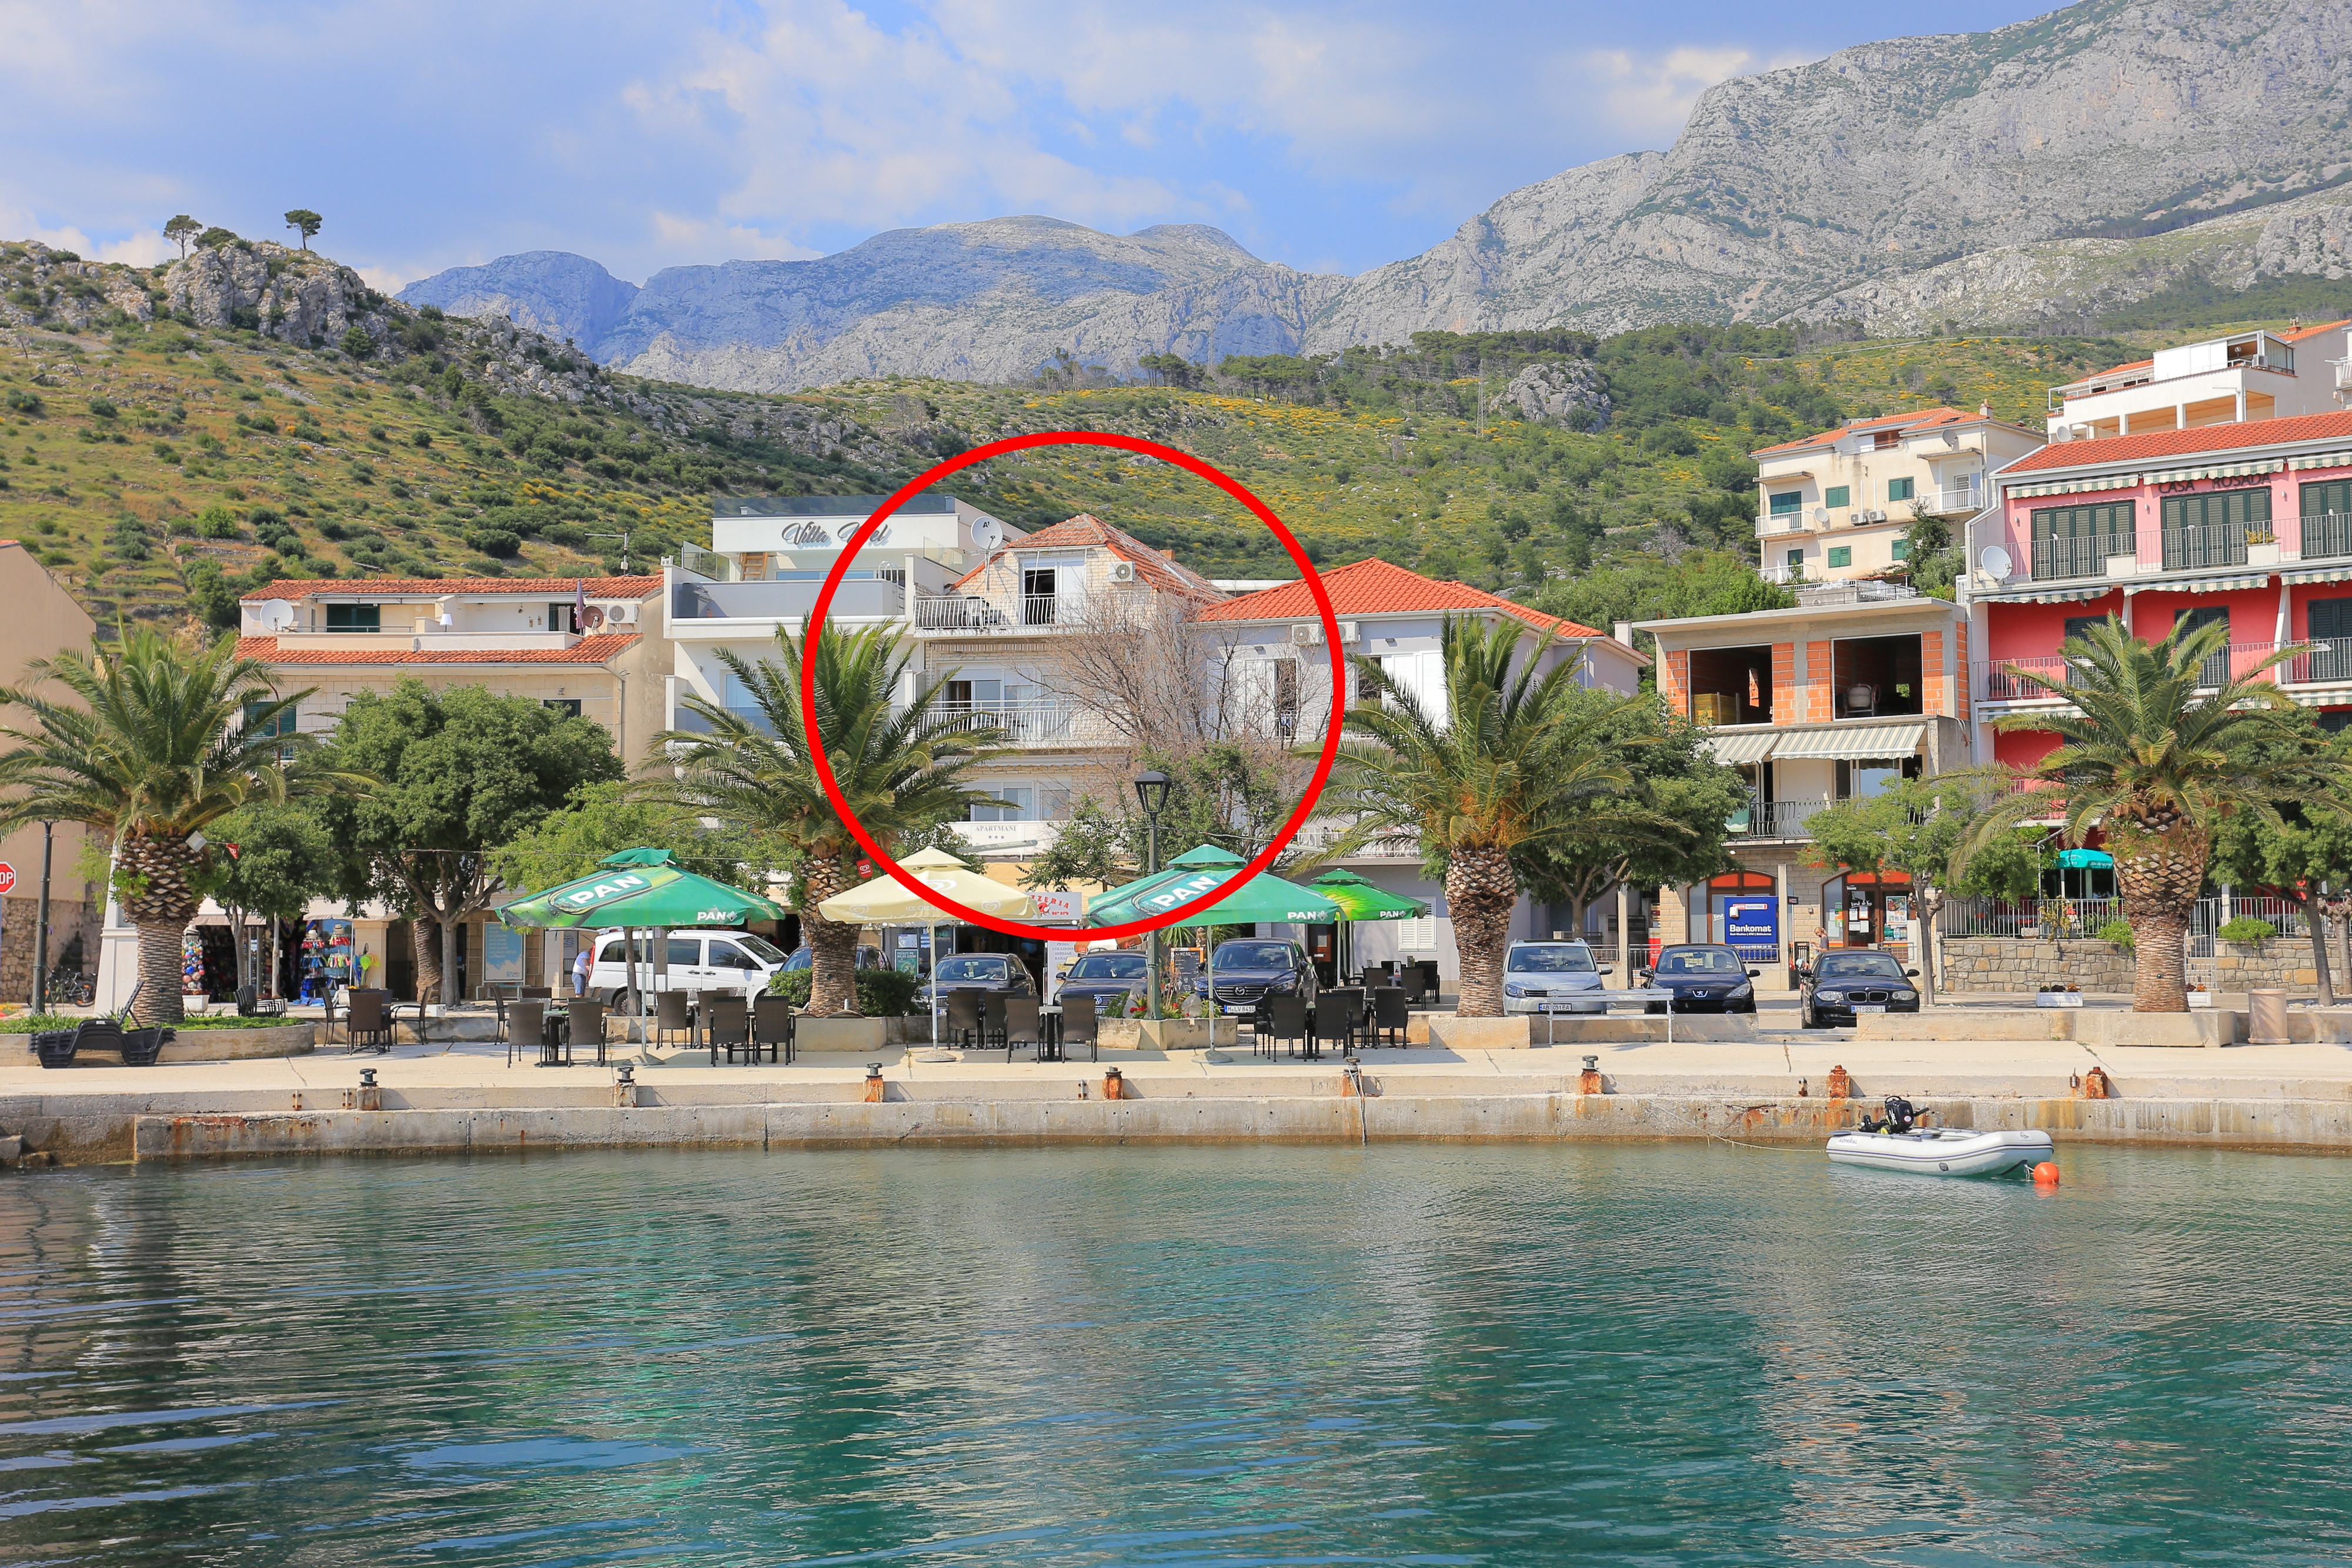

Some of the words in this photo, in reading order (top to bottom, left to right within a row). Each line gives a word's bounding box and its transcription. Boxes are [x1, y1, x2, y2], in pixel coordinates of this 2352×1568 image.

[2159, 480, 2195, 493] CASA
[2212, 474, 2272, 489] ROSADA
[781, 521, 828, 545] Villa
[0, 871, 14, 884] OP
[567, 875, 644, 904] PAN
[1150, 876, 1218, 907] PAN
[1030, 895, 1069, 909] ZZERIA
[697, 911, 726, 921] PAN
[1287, 911, 1317, 921] PAN
[1729, 924, 1772, 932] Bankomat
